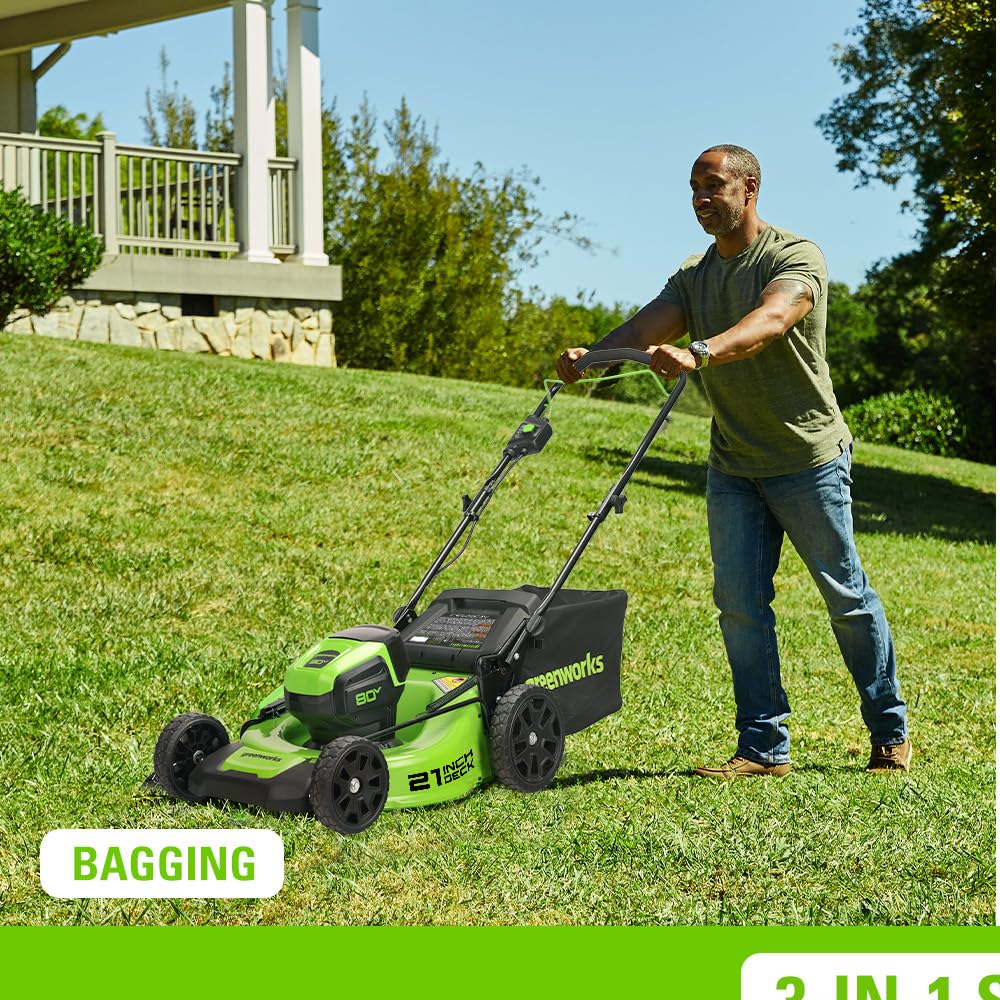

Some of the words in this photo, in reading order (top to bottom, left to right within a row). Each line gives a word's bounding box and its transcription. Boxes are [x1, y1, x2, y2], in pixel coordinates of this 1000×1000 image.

[525, 652, 604, 690] reenworks
[355, 686, 382, 706] 80V
[408, 767, 442, 792] 21
[443, 749, 473, 775] INCH
[444, 758, 475, 784] DECK
